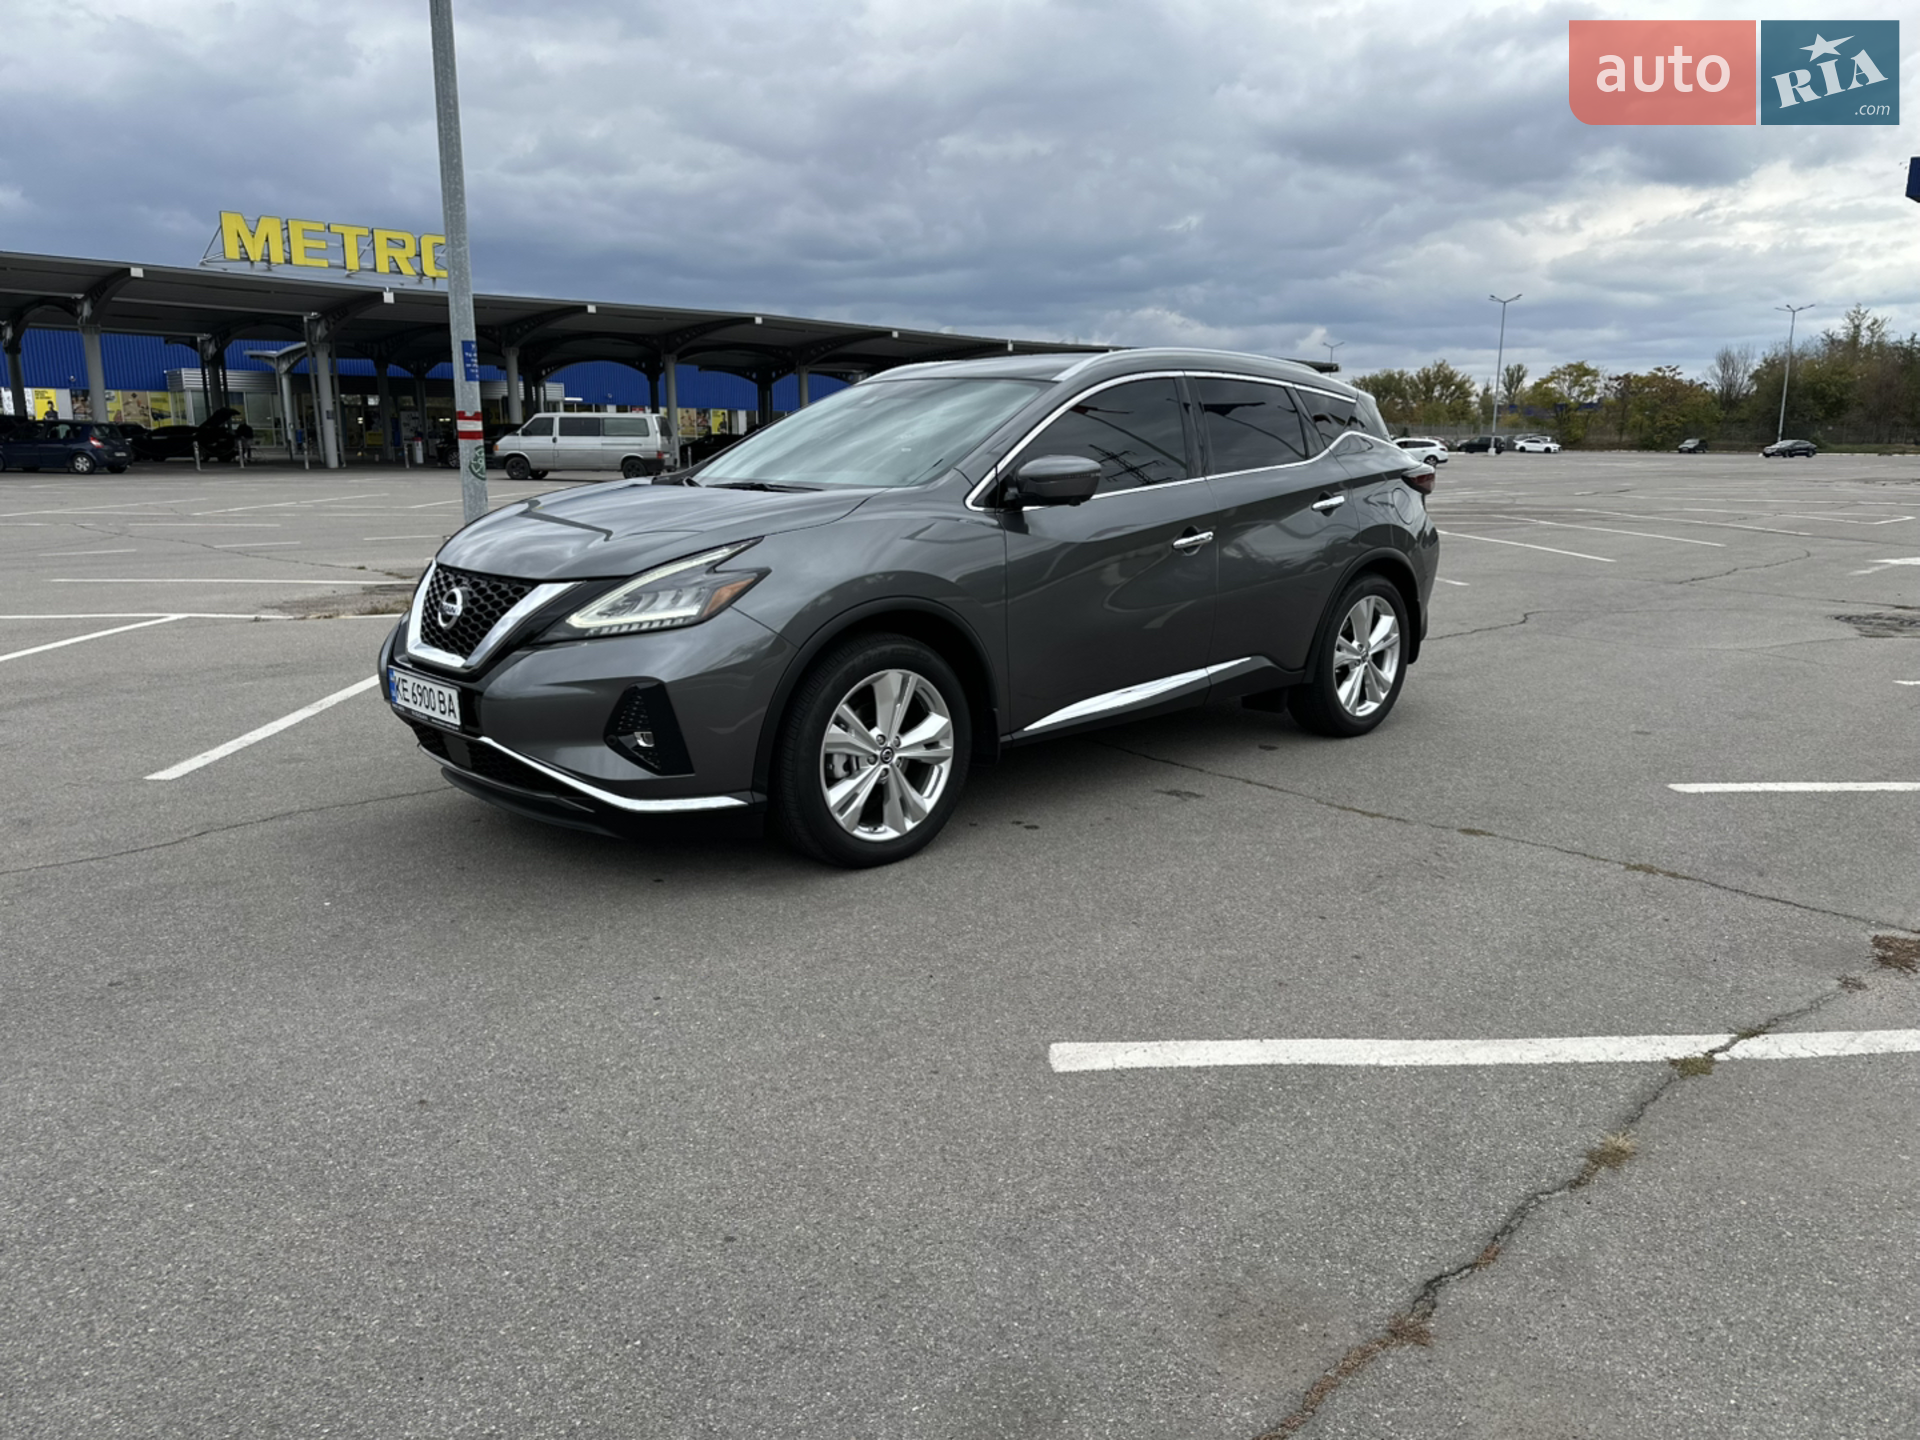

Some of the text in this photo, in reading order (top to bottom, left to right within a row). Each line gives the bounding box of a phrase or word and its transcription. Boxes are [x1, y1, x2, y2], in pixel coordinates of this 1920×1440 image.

[395, 675, 457, 719] KE 6900 BA
